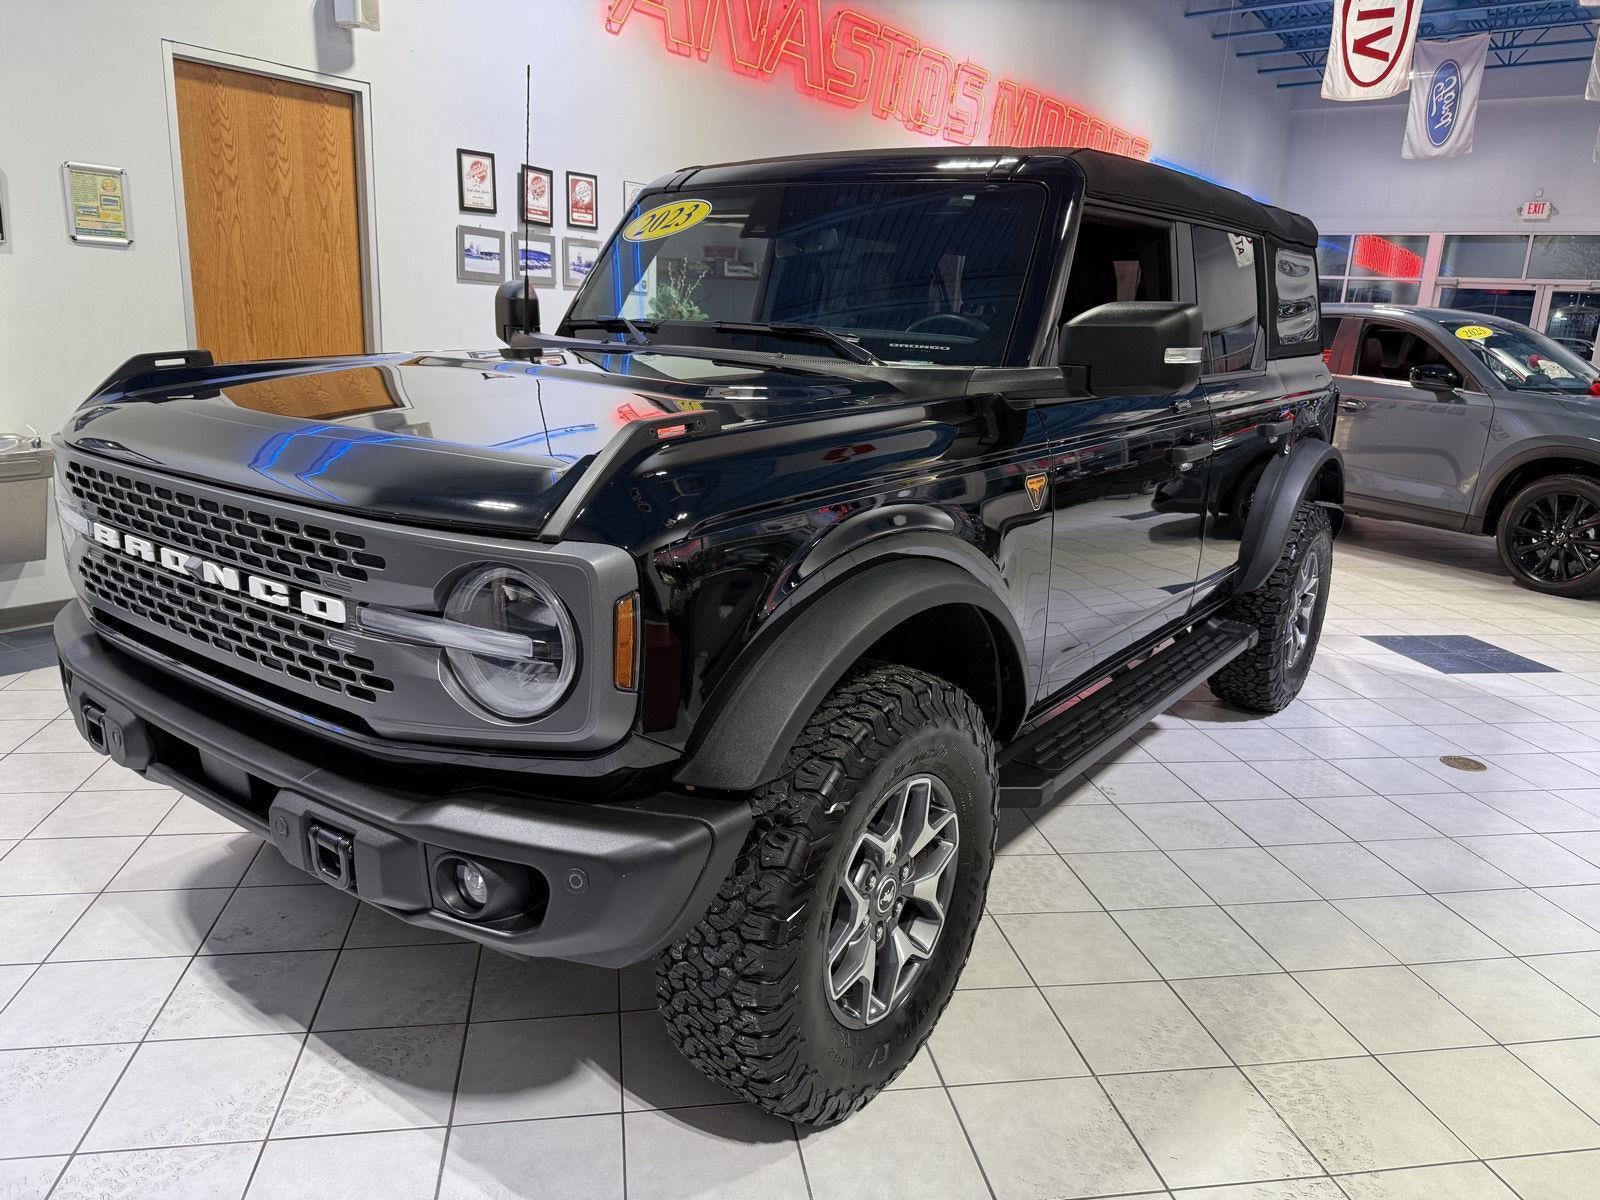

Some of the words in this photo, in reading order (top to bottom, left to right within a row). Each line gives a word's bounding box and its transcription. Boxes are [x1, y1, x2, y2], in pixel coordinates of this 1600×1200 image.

[633, 203, 700, 237] 2023
[1527, 203, 1546, 215] EXIT
[93, 522, 347, 624] BRONCO
